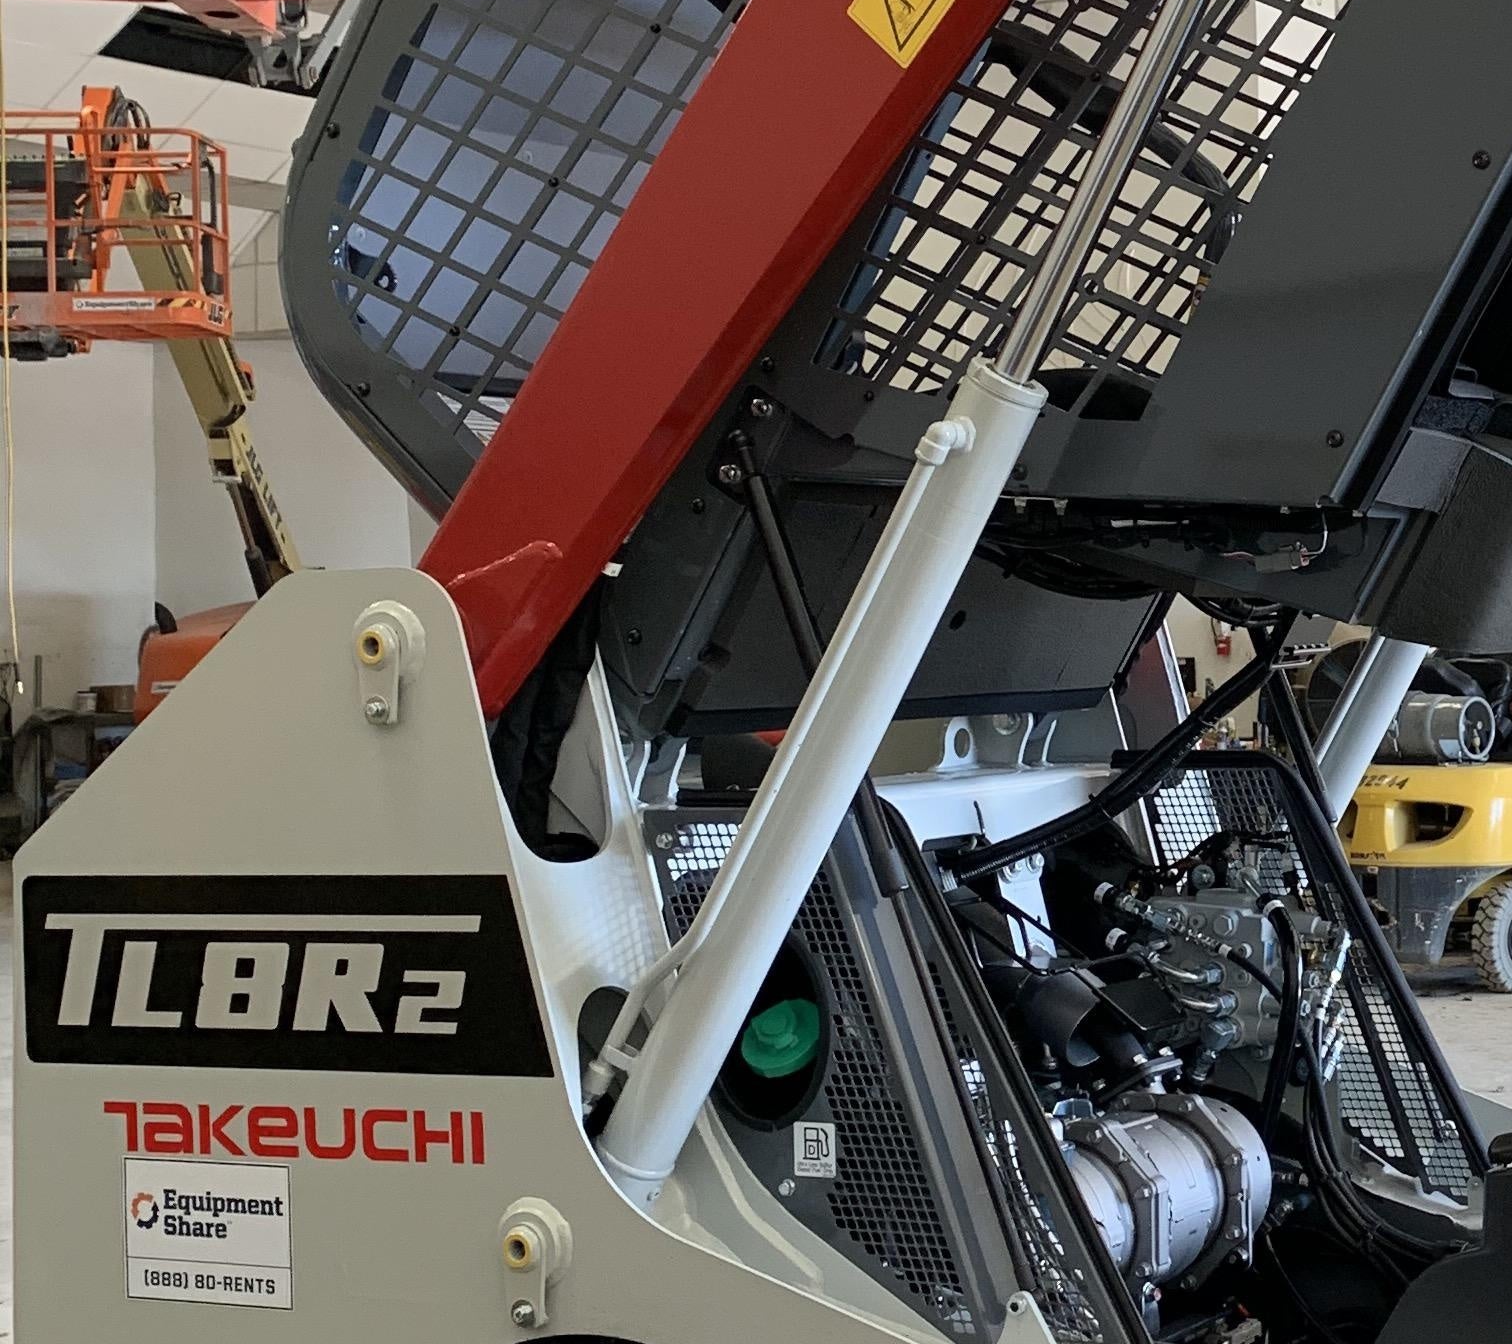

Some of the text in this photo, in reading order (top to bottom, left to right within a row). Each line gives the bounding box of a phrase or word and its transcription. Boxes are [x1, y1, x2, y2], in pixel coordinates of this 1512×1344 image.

[44, 913, 483, 1035] TL8R2
[162, 1188, 284, 1218] Equipment
[163, 1214, 228, 1239] Share
[143, 1268, 276, 1296] (888) 80-RENTS
